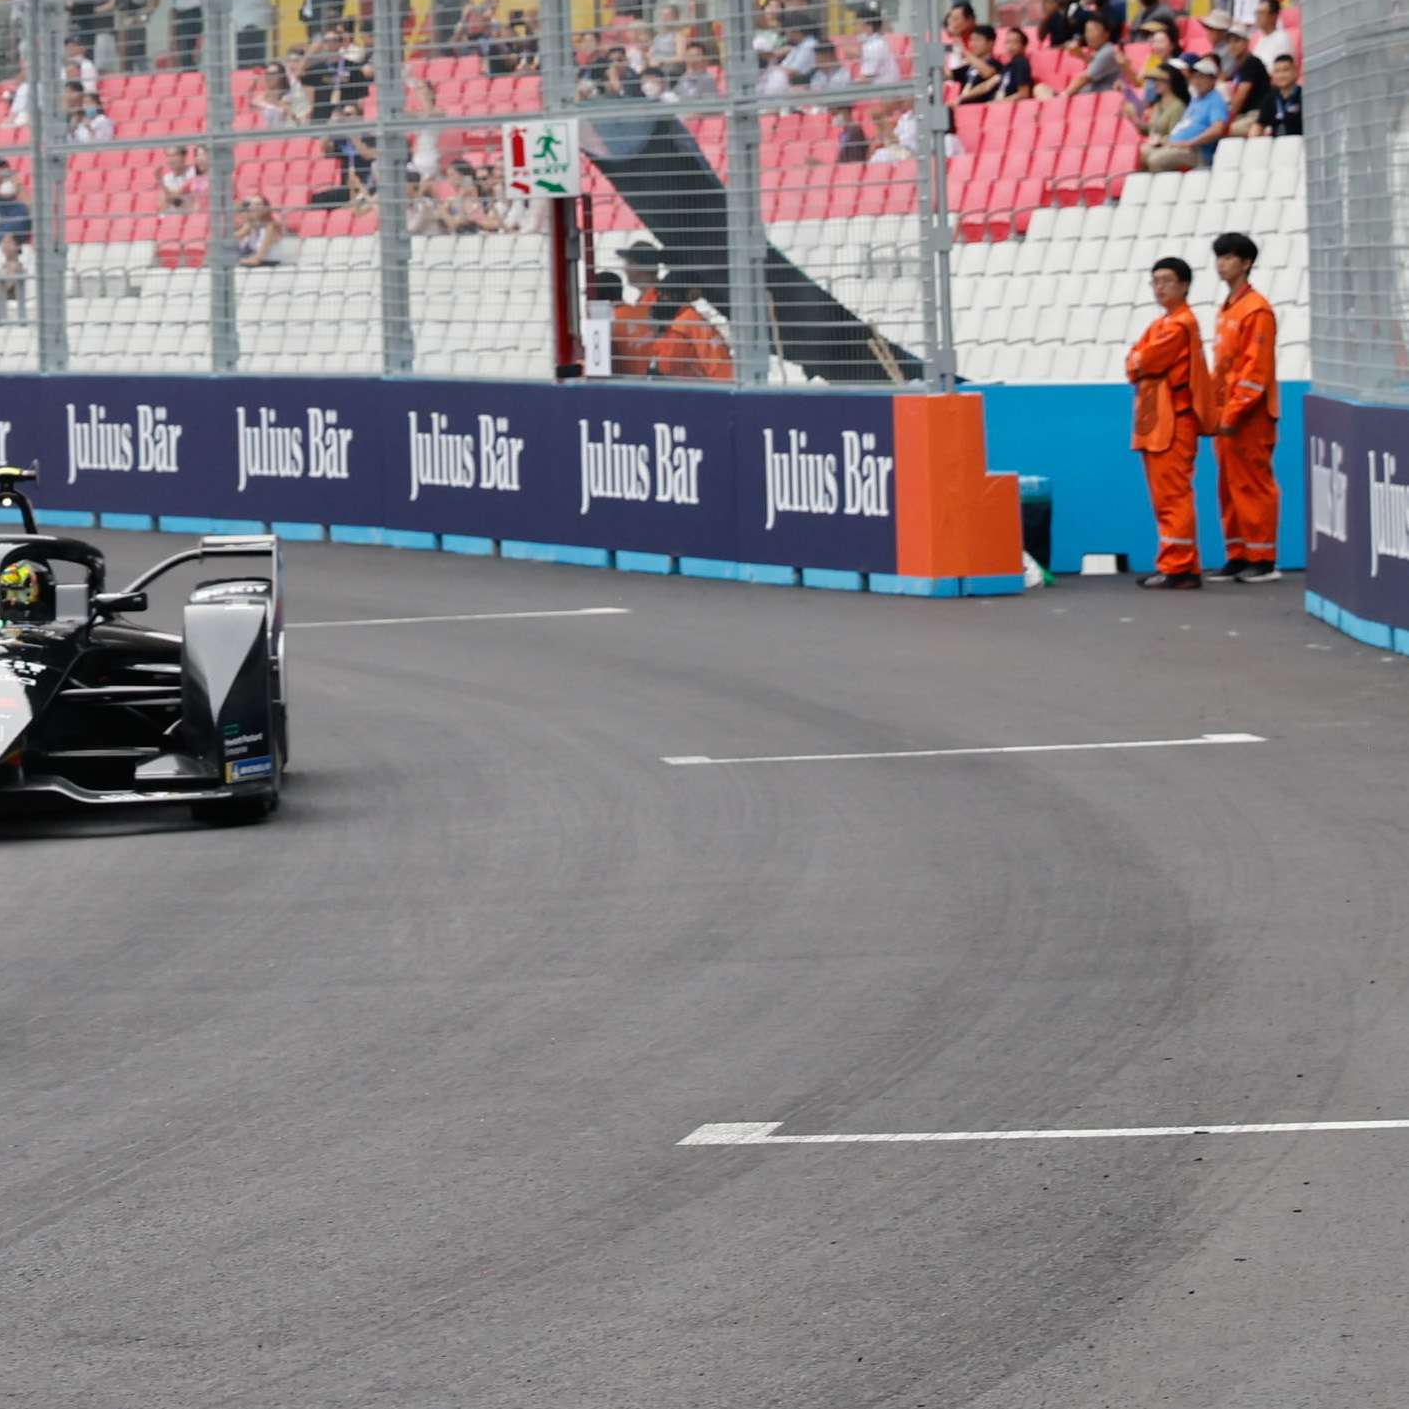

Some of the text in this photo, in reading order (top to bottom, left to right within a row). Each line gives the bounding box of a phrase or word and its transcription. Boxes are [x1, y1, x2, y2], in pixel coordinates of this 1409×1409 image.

[67, 404, 182, 484] Julius Bär
[237, 407, 353, 492] Julius Bär
[409, 411, 524, 501] Julius Bär
[580, 419, 703, 515] Julius Bär
[764, 429, 893, 531] Julius Bär
